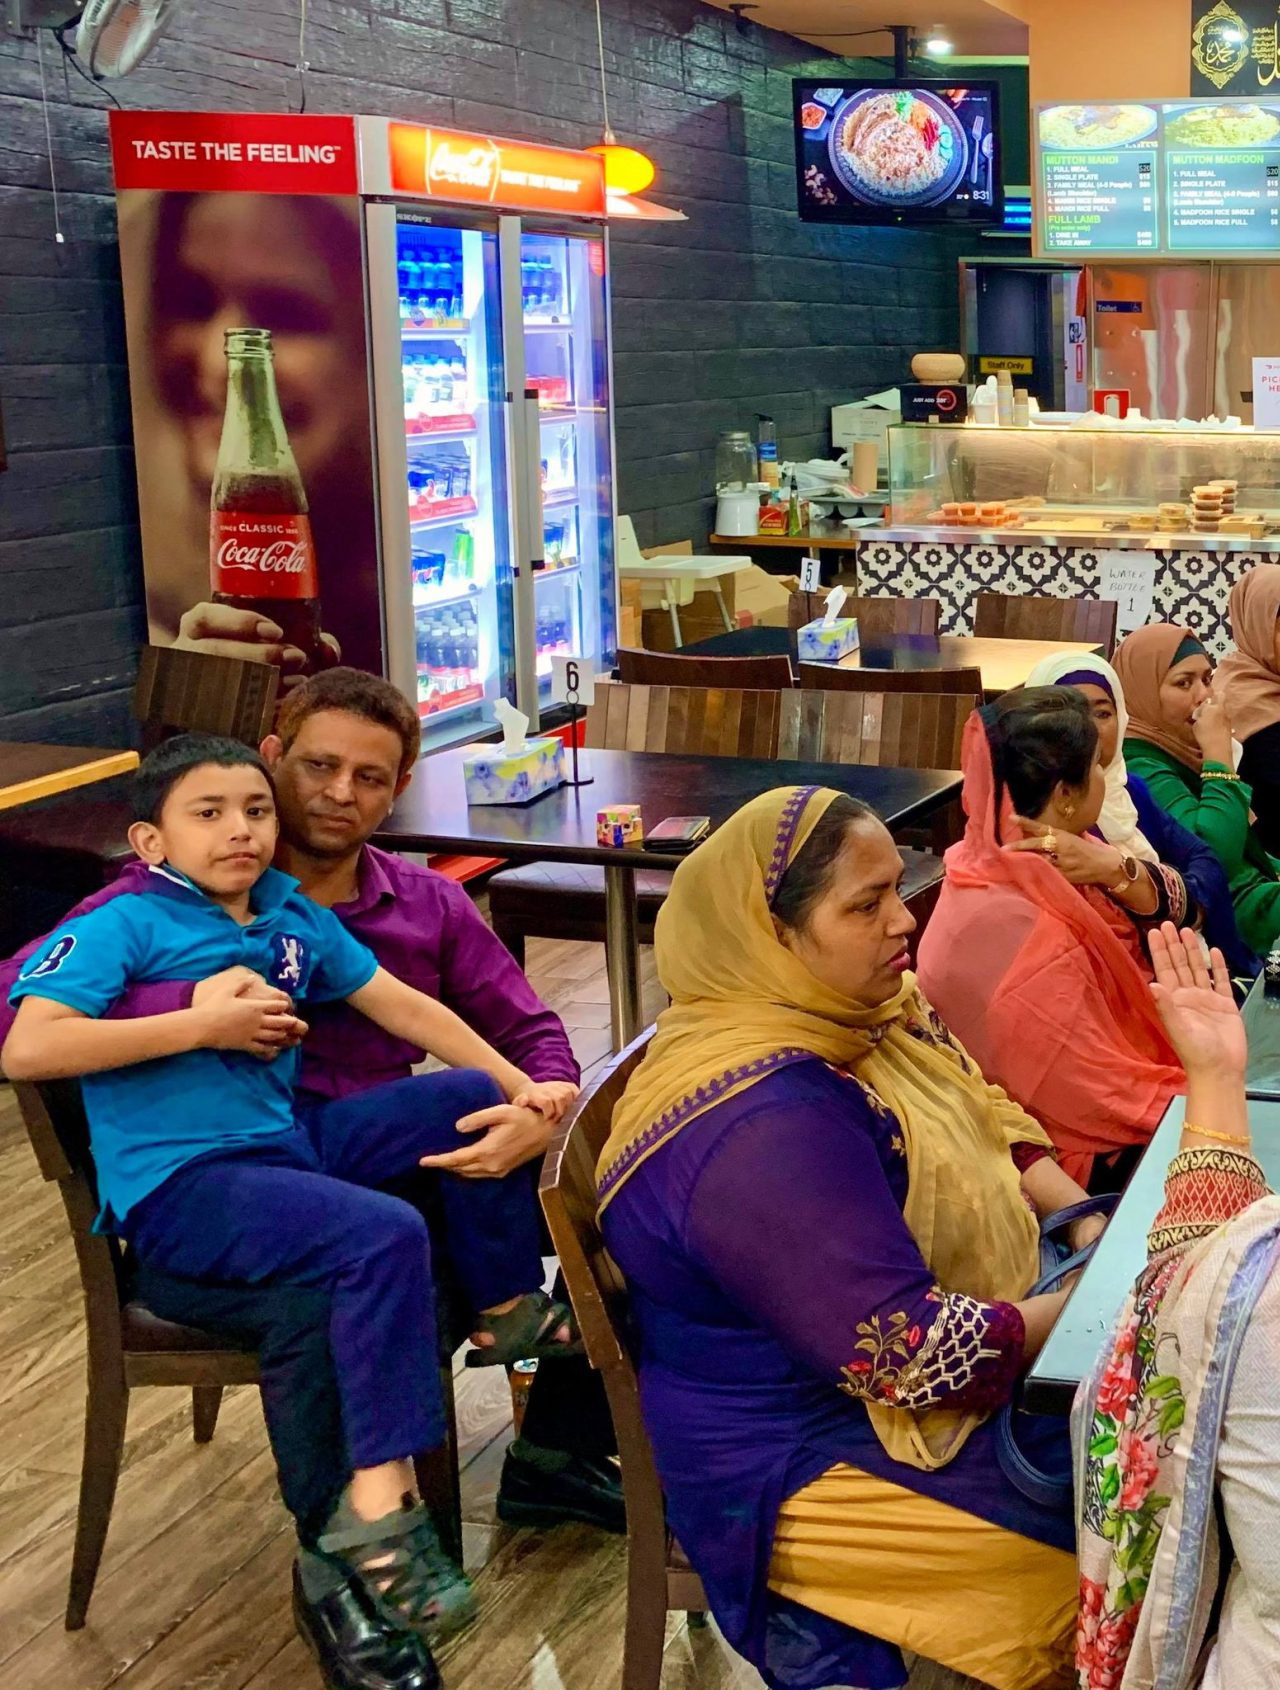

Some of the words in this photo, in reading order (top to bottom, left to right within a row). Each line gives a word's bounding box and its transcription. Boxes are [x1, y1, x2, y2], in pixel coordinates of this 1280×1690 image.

[132, 141, 196, 159] TASTE
[201, 143, 241, 161] THE
[1046, 155, 1086, 164] MUTTON
[1088, 156, 1118, 164] MANDI
[1173, 156, 1213, 164] MUTTON
[1216, 155, 1264, 163] MADFOON
[987, 361, 1004, 370] Staff
[1007, 361, 1024, 371] Only
[239, 524, 284, 533] CLASSIC
[217, 539, 307, 573] Coca-Cola
[806, 562, 813, 582] 5
[1109, 569, 1146, 578] WATER
[1109, 583, 1145, 592] BOTTLE
[1127, 598, 1134, 612] 1
[565, 661, 579, 692] 6
[19, 934, 77, 981] B
